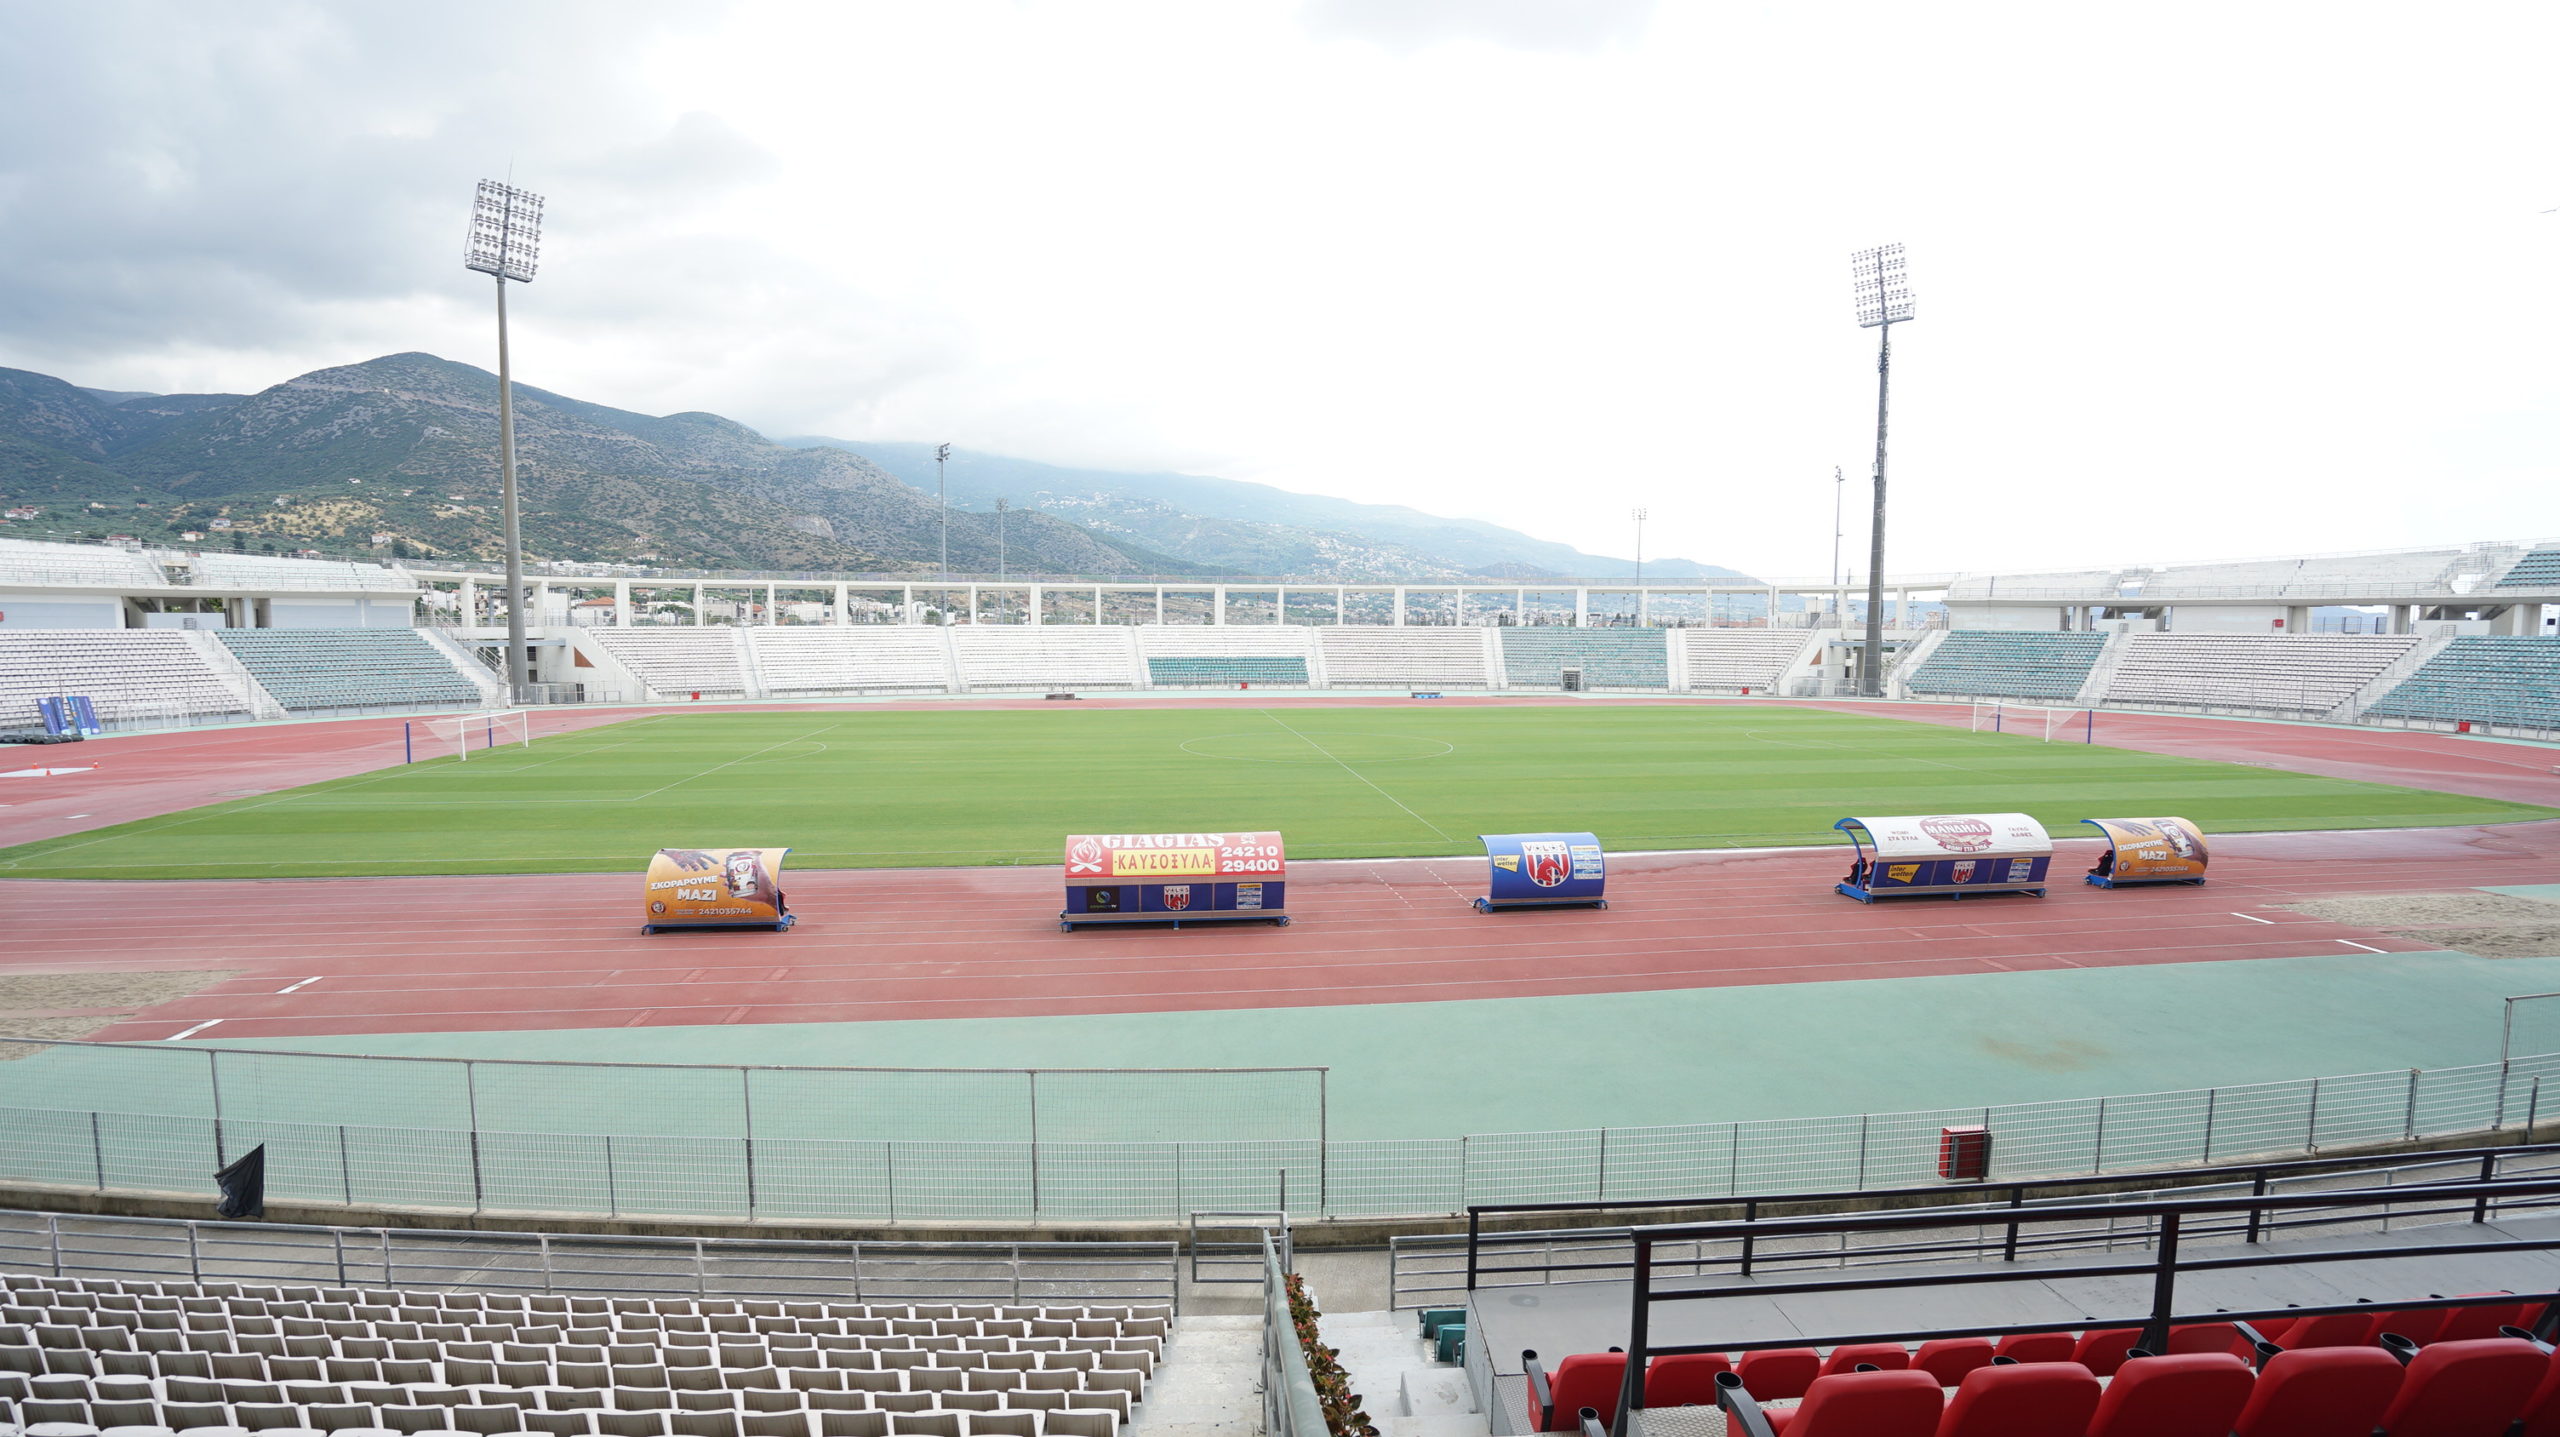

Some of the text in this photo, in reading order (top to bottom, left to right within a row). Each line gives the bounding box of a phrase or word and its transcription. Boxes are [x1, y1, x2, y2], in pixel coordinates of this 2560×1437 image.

[1926, 823, 1990, 834] ΜΑΝΔΗΛΑ
[1102, 833, 1225, 849] GIAGIAS
[1221, 846, 1279, 858] 24210
[2139, 851, 2167, 860] ΜΑΖΙ
[1117, 853, 1212, 870] ΚΑΥΣΟΞΥΛΑ
[1222, 859, 1280, 873] 29400
[650, 875, 718, 890] ΣΚΟΡΑΡΟΥΜΕ
[677, 888, 717, 901] ΜΑΖΙ
